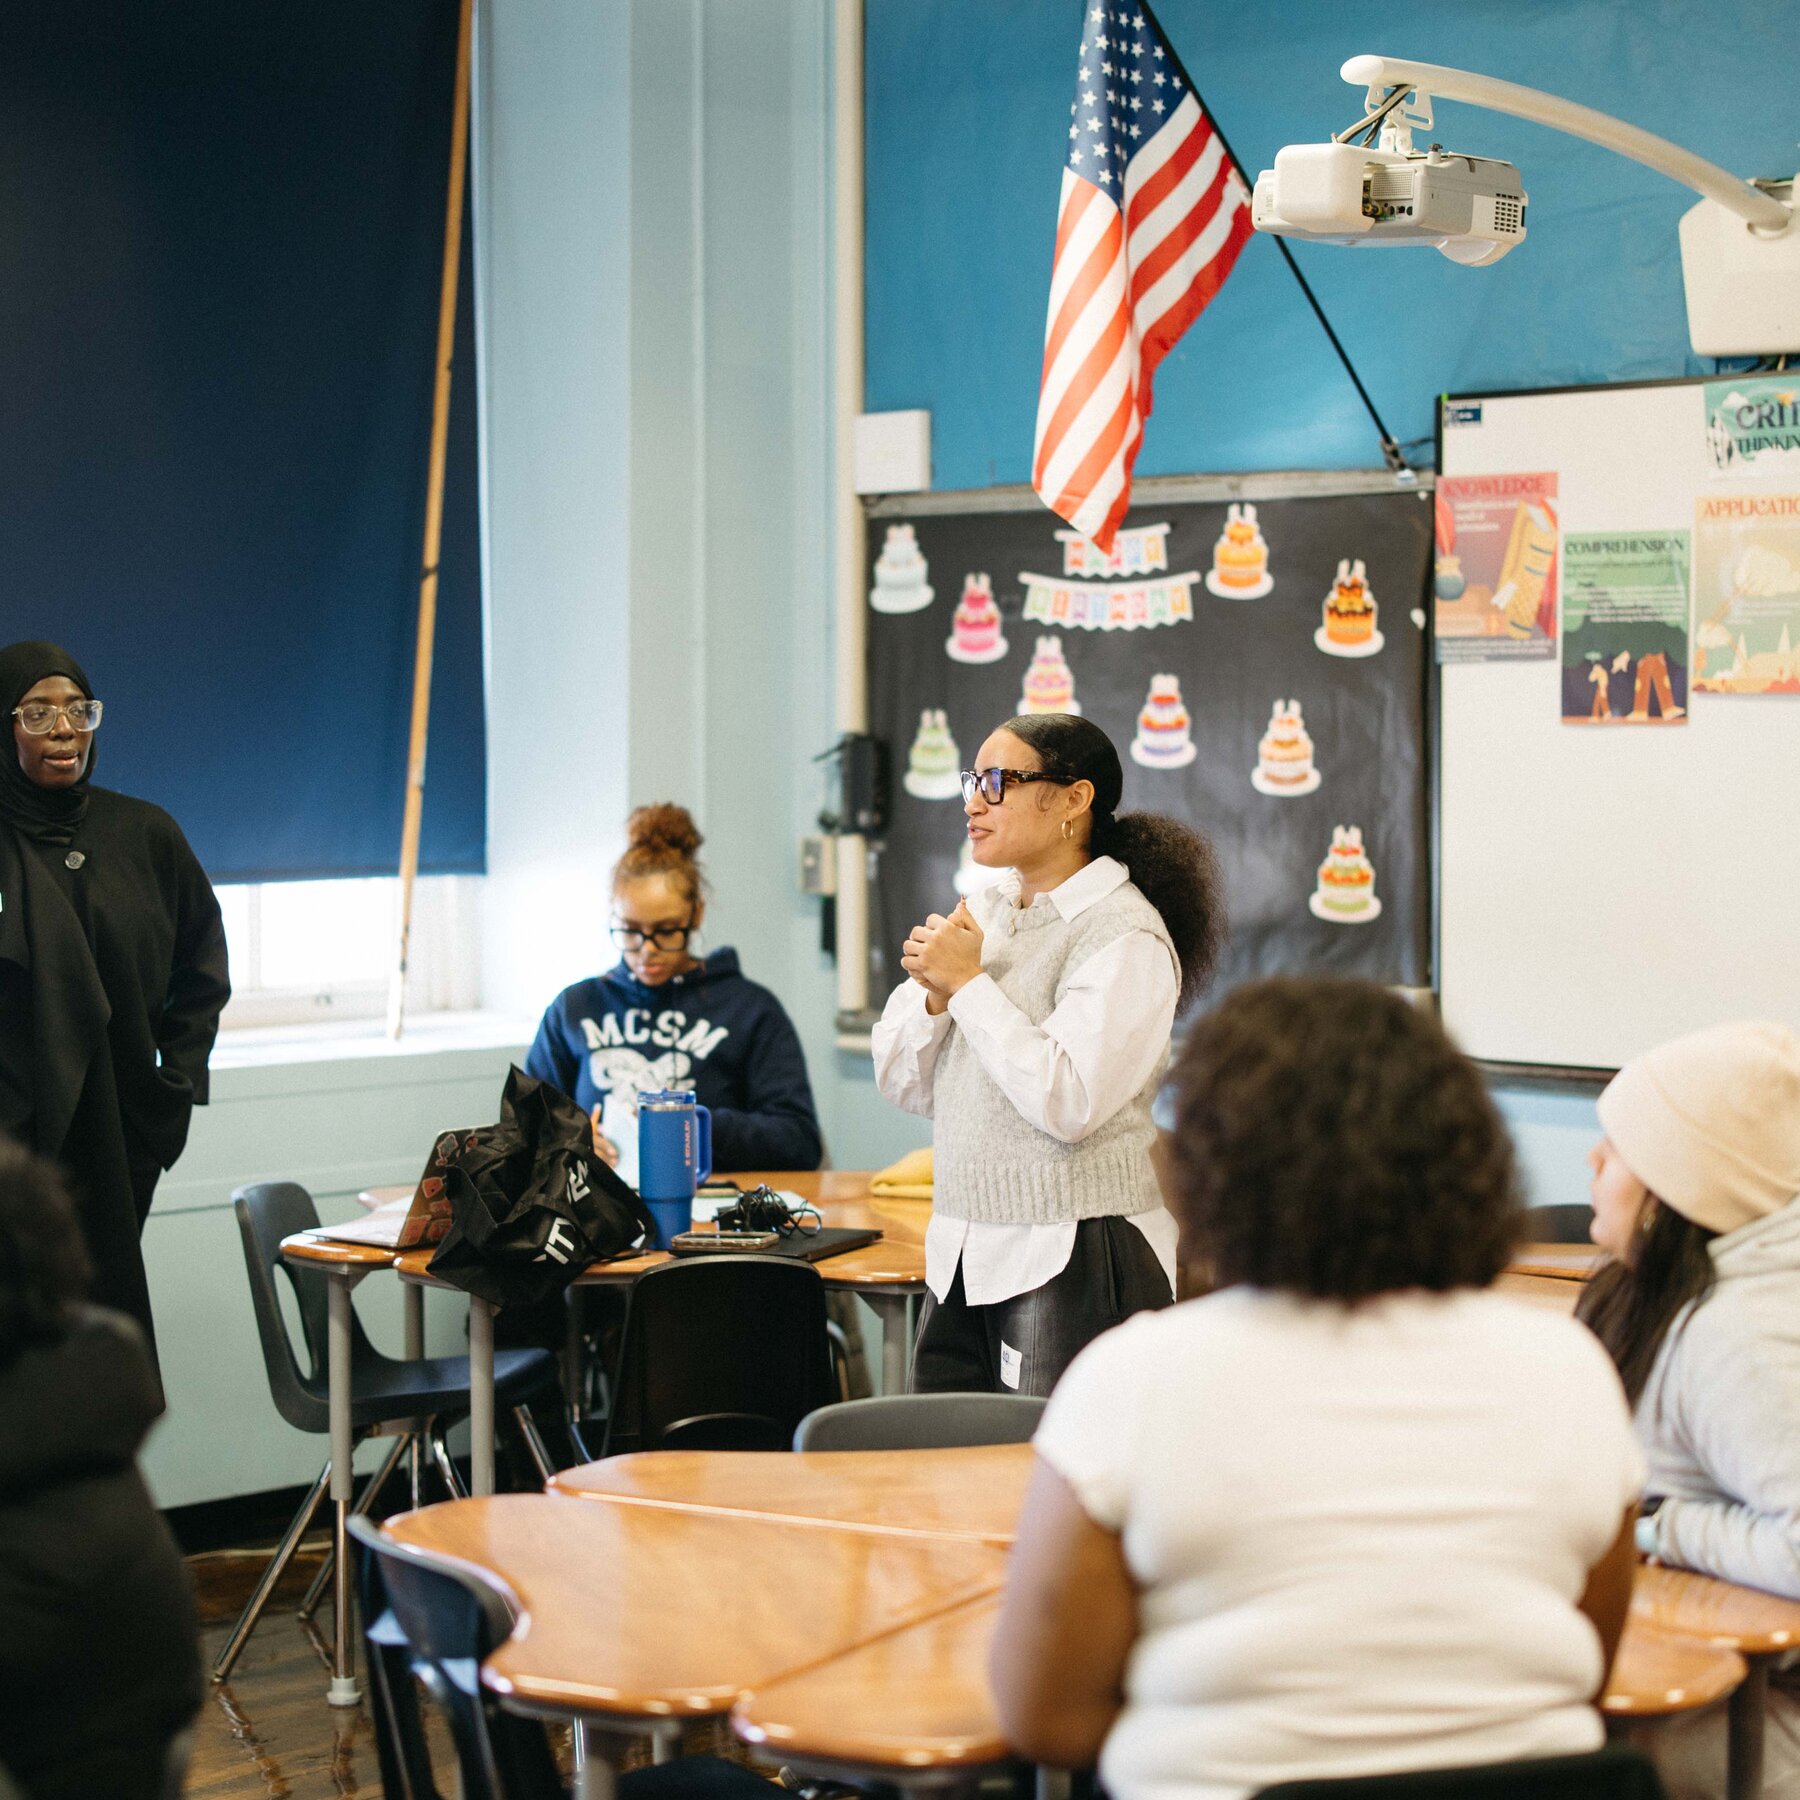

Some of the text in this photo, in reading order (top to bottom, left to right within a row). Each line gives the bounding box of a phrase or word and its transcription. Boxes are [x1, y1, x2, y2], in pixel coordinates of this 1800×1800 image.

[1444, 476, 1545, 497] KNOWLEDGE
[1565, 537, 1684, 555] COMPREHENSION
[580, 1007, 729, 1060] MCSM
